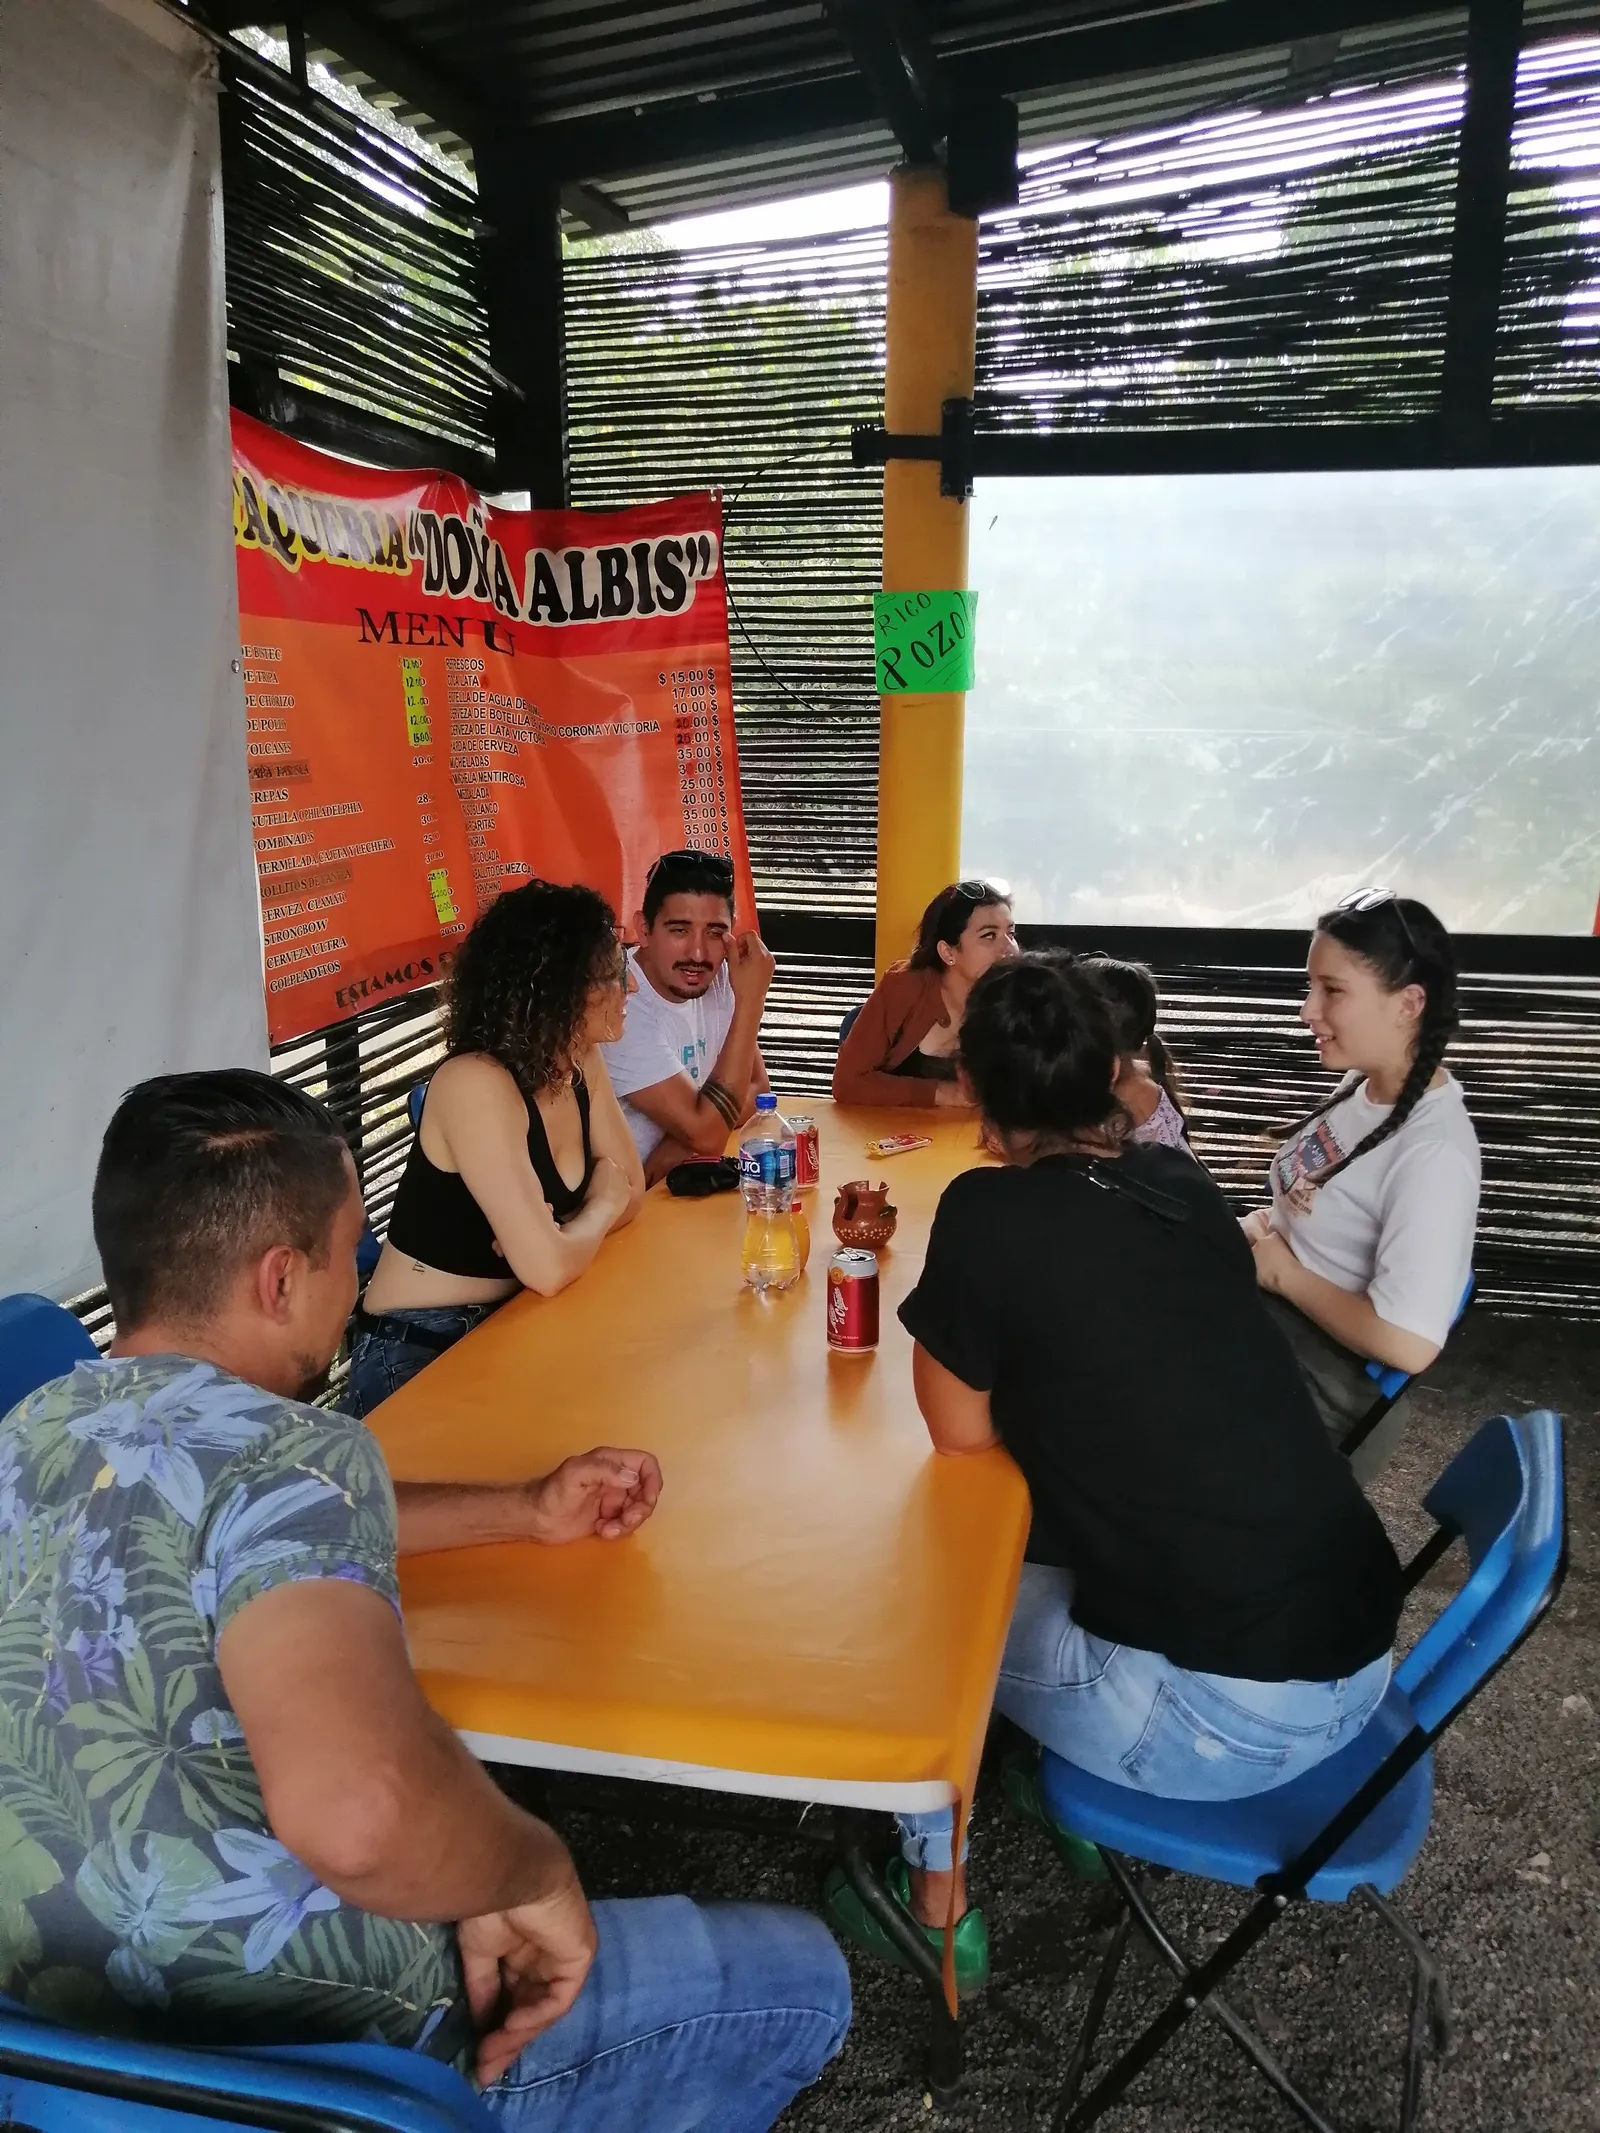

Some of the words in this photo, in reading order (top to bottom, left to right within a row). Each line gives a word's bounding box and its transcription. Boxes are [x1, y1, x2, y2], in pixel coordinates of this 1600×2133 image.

[231, 474, 410, 572] AQUERIA
[876, 592, 931, 637] RICO
[355, 607, 515, 656] MENU
[658, 673, 666, 685] $
[670, 671, 703, 684] 15.00
[707, 668, 715, 681] $
[672, 686, 705, 699] 17.00
[709, 684, 717, 696] $
[472, 691, 486, 703] DE
[488, 692, 513, 709] AGUA
[673, 701, 707, 713] 10.00
[710, 699, 718, 711] $
[473, 707, 487, 719] DE
[489, 708, 530, 726] BOTELLA
[558, 725, 602, 738] CORONA
[603, 723, 611, 735] Y
[612, 719, 661, 735] VICTORIA
[711, 714, 720, 726] $
[489, 723, 512, 739] LATA
[713, 730, 721, 742] $
[478, 739, 519, 755] CERVEZA
[678, 746, 711, 759] 35.00
[714, 745, 722, 757] $
[679, 762, 712, 775] 3.00
[716, 760, 723, 772] $
[680, 777, 714, 790] 25.00
[717, 775, 725, 787] $
[682, 792, 715, 805] 40.00
[718, 790, 726, 802] $
[305, 801, 363, 820] PHILADELPHIA
[683, 807, 716, 820] 35.00
[720, 805, 728, 817] $
[684, 822, 717, 835] 35.00
[721, 821, 729, 832] $
[355, 838, 395, 855] LECHERA
[685, 837, 719, 850] 40.00
[722, 835, 730, 847] $
[505, 862, 537, 877] MEZCAL
[262, 902, 304, 922] CERVEZA
[264, 919, 328, 946] STRONGBOW
[440, 923, 466, 937] 20.00
[267, 947, 311, 969] CERVEZA
[311, 936, 347, 955] ULTRA
[270, 961, 341, 992] GOLPEADITOS
[335, 956, 434, 1009] ESTAMOS
